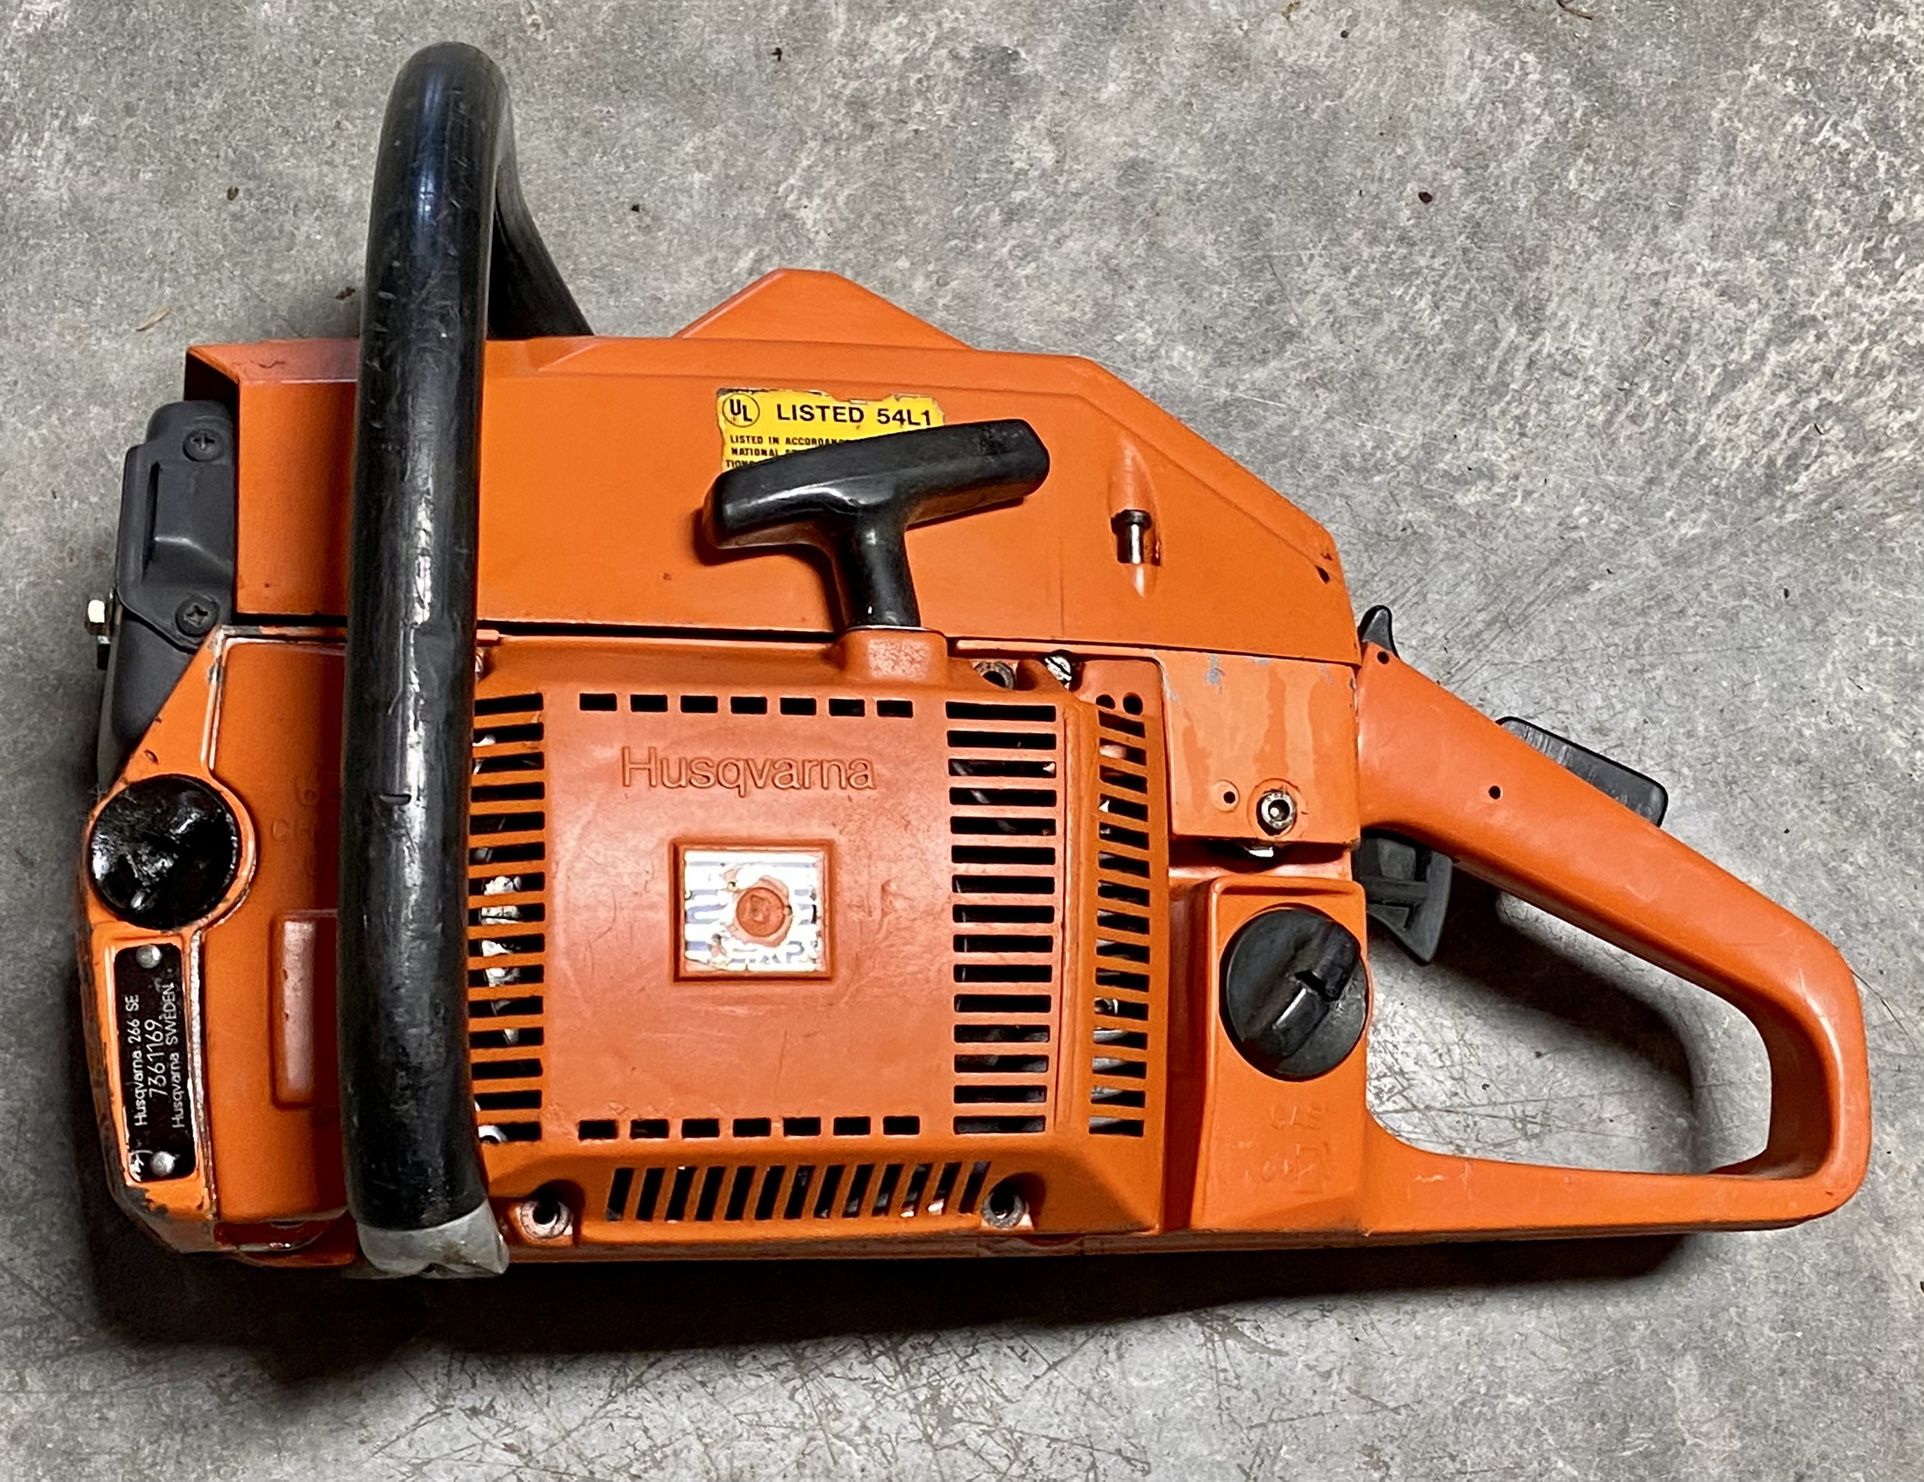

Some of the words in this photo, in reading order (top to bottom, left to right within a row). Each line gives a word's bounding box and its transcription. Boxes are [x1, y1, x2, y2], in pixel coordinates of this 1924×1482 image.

[729, 399, 753, 422] UL
[777, 404, 864, 423] LISTED
[877, 408, 931, 426] 54L1
[730, 435, 764, 445] LISTED
[768, 436, 780, 445] IN
[621, 746, 876, 798] Husqvarna
[124, 994, 140, 1012] SE
[161, 982, 179, 1046] SWEDEN
[126, 1018, 142, 1044] 266
[144, 1019, 169, 1098] 7361169
[132, 1050, 148, 1126] Husqvarna
[169, 1052, 186, 1129] Husqvarna
